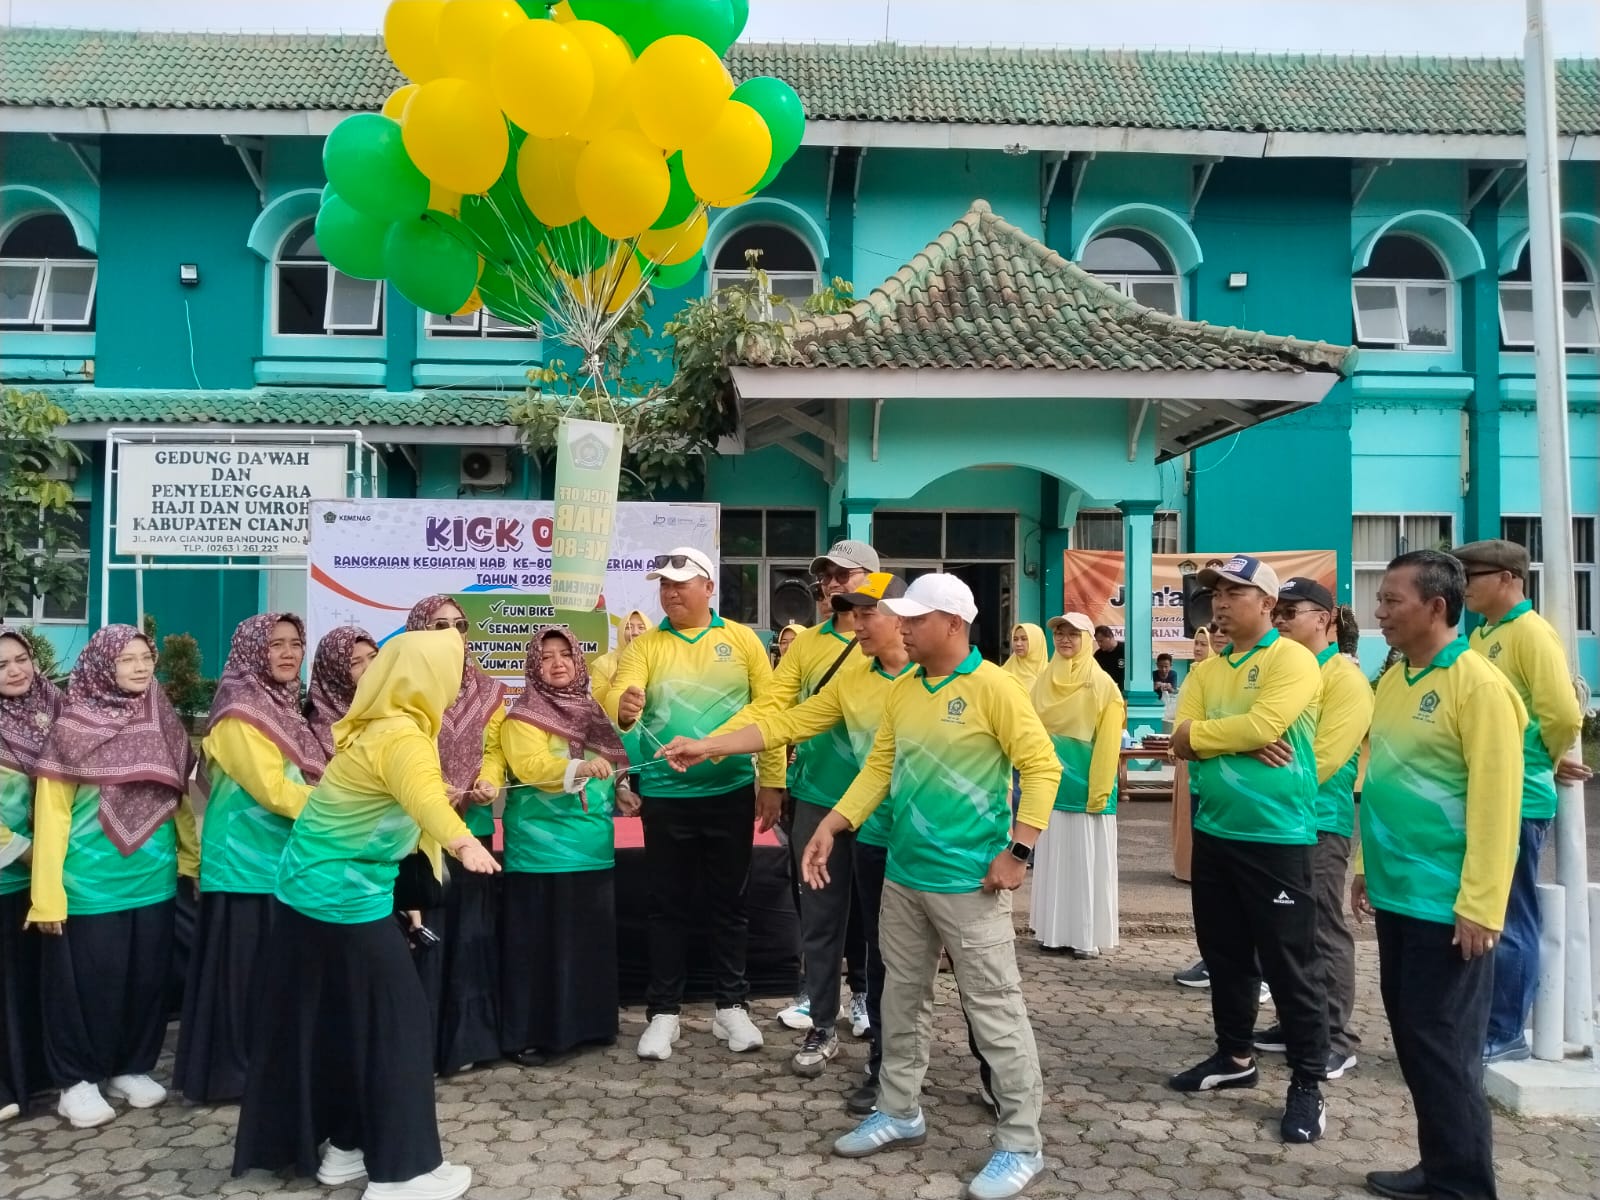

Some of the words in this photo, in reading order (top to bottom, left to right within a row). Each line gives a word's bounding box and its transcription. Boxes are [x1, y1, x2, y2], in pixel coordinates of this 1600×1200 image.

[155, 451, 231, 465] GEDUNG
[237, 451, 310, 466] DA'WAH
[212, 468, 251, 481] DAN
[152, 484, 311, 498] PENYELENGGARA
[152, 501, 194, 514] HAJI
[200, 501, 239, 514] DAN
[245, 501, 309, 515] UMROH
[133, 517, 241, 531] KABUPATEN
[150, 535, 176, 543] RAYA
[179, 535, 223, 543] CIANJUR
[227, 535, 279, 543] BANDUNG
[425, 516, 524, 552] KICK
[334, 556, 409, 569] RANGKAIAN
[413, 557, 476, 569] KEGIATAN
[479, 558, 506, 569] HAB
[513, 558, 552, 569] KE-80
[477, 573, 518, 586] TAHUN
[521, 574, 552, 586] 2026
[502, 606, 526, 616] FUN
[528, 606, 555, 617] BIKE
[488, 623, 529, 634] SENAM
[468, 641, 522, 652] ANTUNAN
[482, 659, 525, 669] JUM'AT
